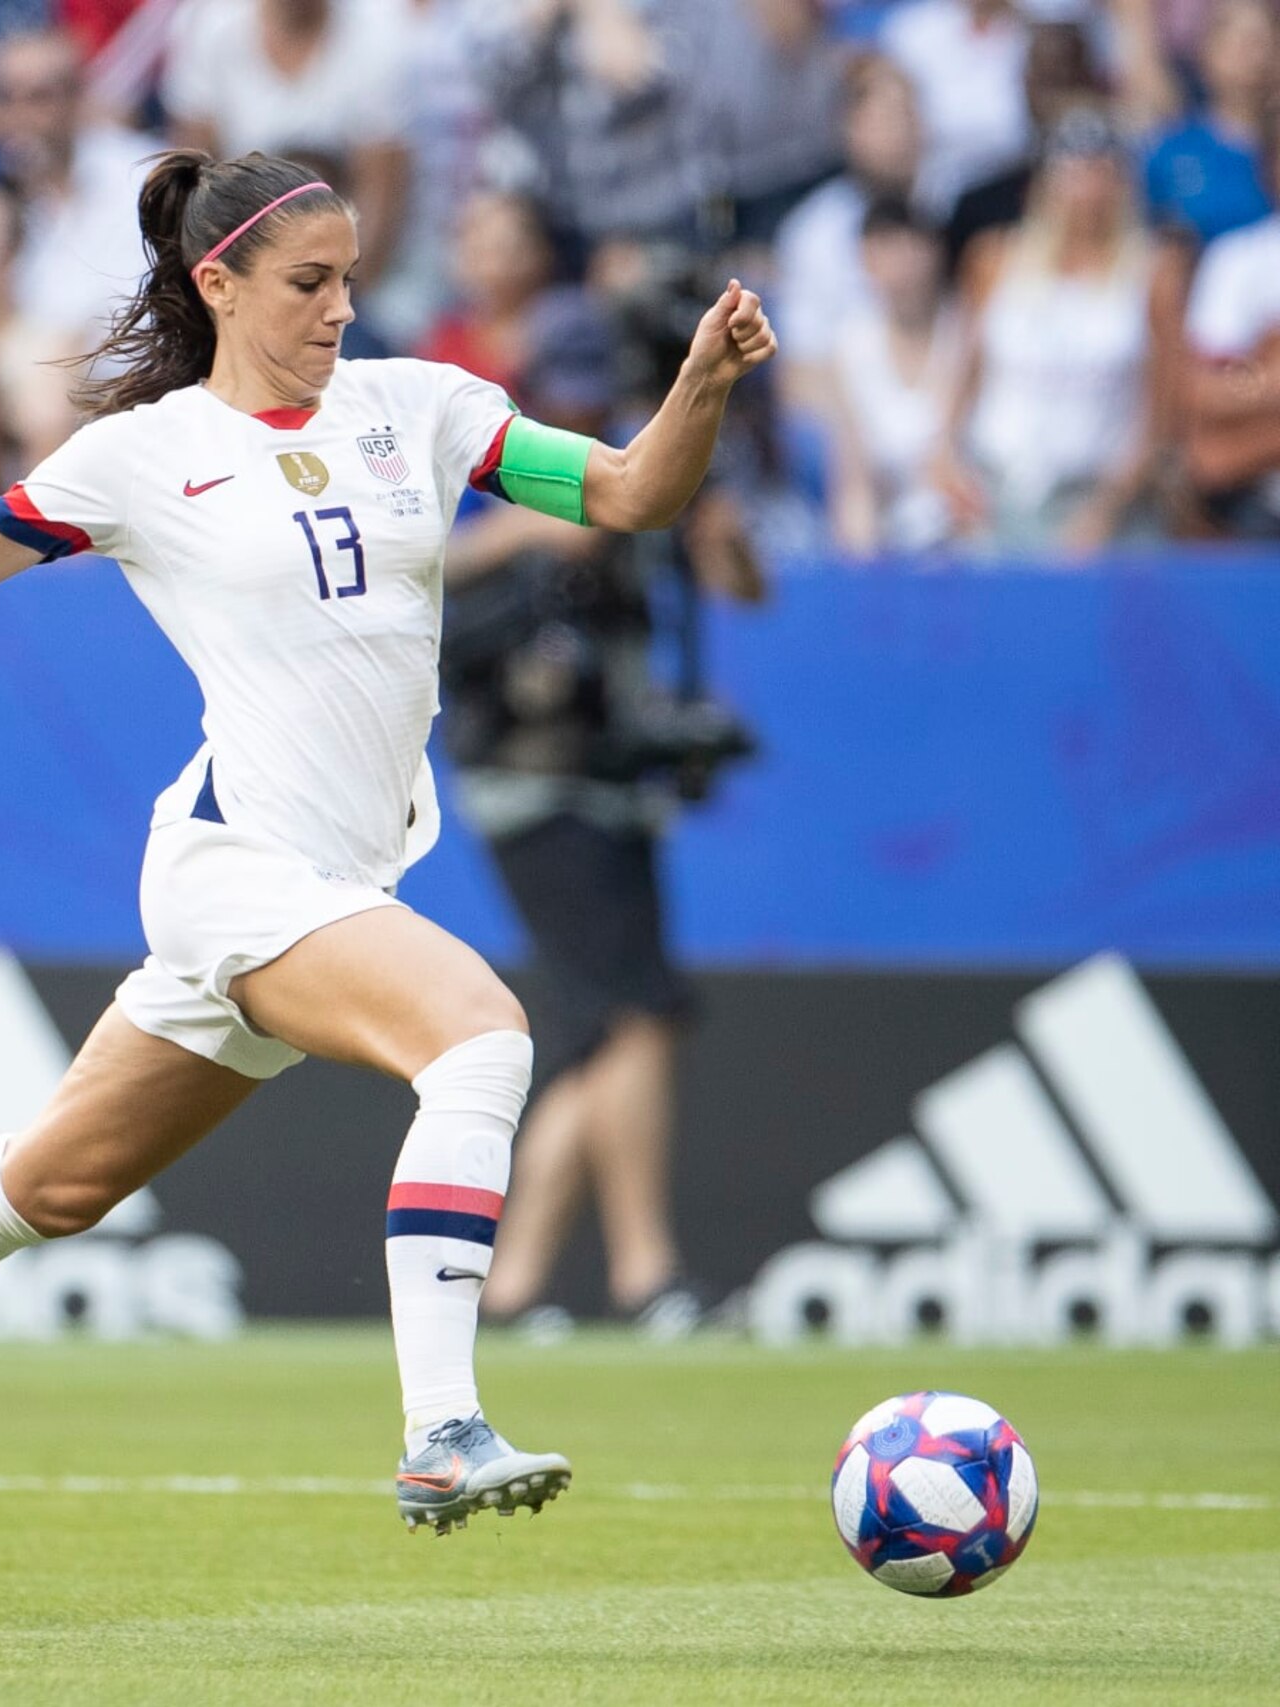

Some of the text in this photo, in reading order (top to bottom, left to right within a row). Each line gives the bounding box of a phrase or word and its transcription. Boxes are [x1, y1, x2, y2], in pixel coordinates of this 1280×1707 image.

[362, 439, 396, 458] USA
[292, 506, 368, 601] 13
[749, 1220, 1280, 1348] adida
